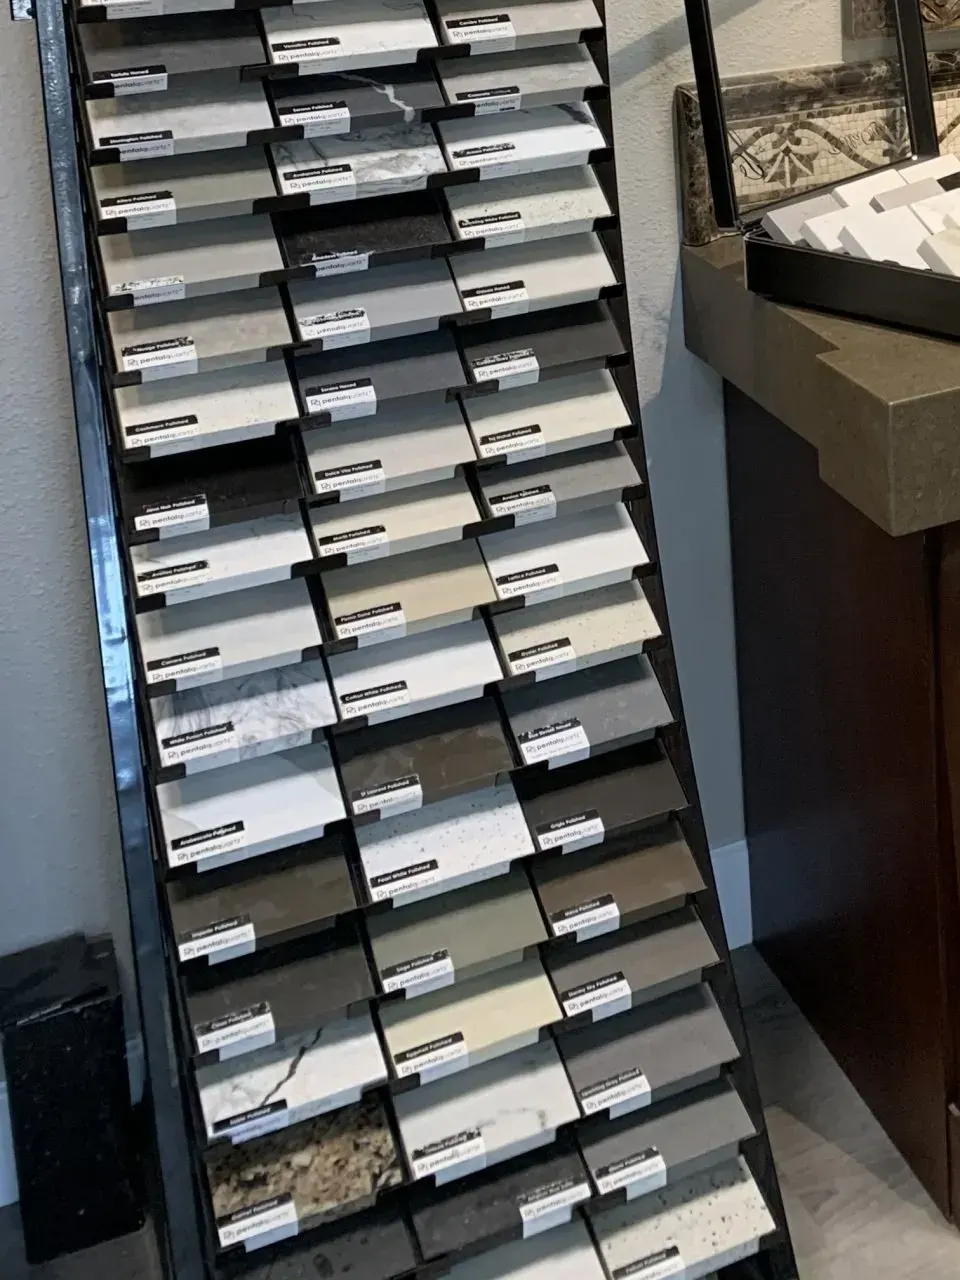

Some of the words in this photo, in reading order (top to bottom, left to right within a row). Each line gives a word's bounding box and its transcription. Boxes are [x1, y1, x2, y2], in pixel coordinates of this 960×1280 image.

[114, 78, 160, 89] entalquartz
[120, 143, 167, 154] entalquartz
[317, 258, 362, 273] entalquartz
